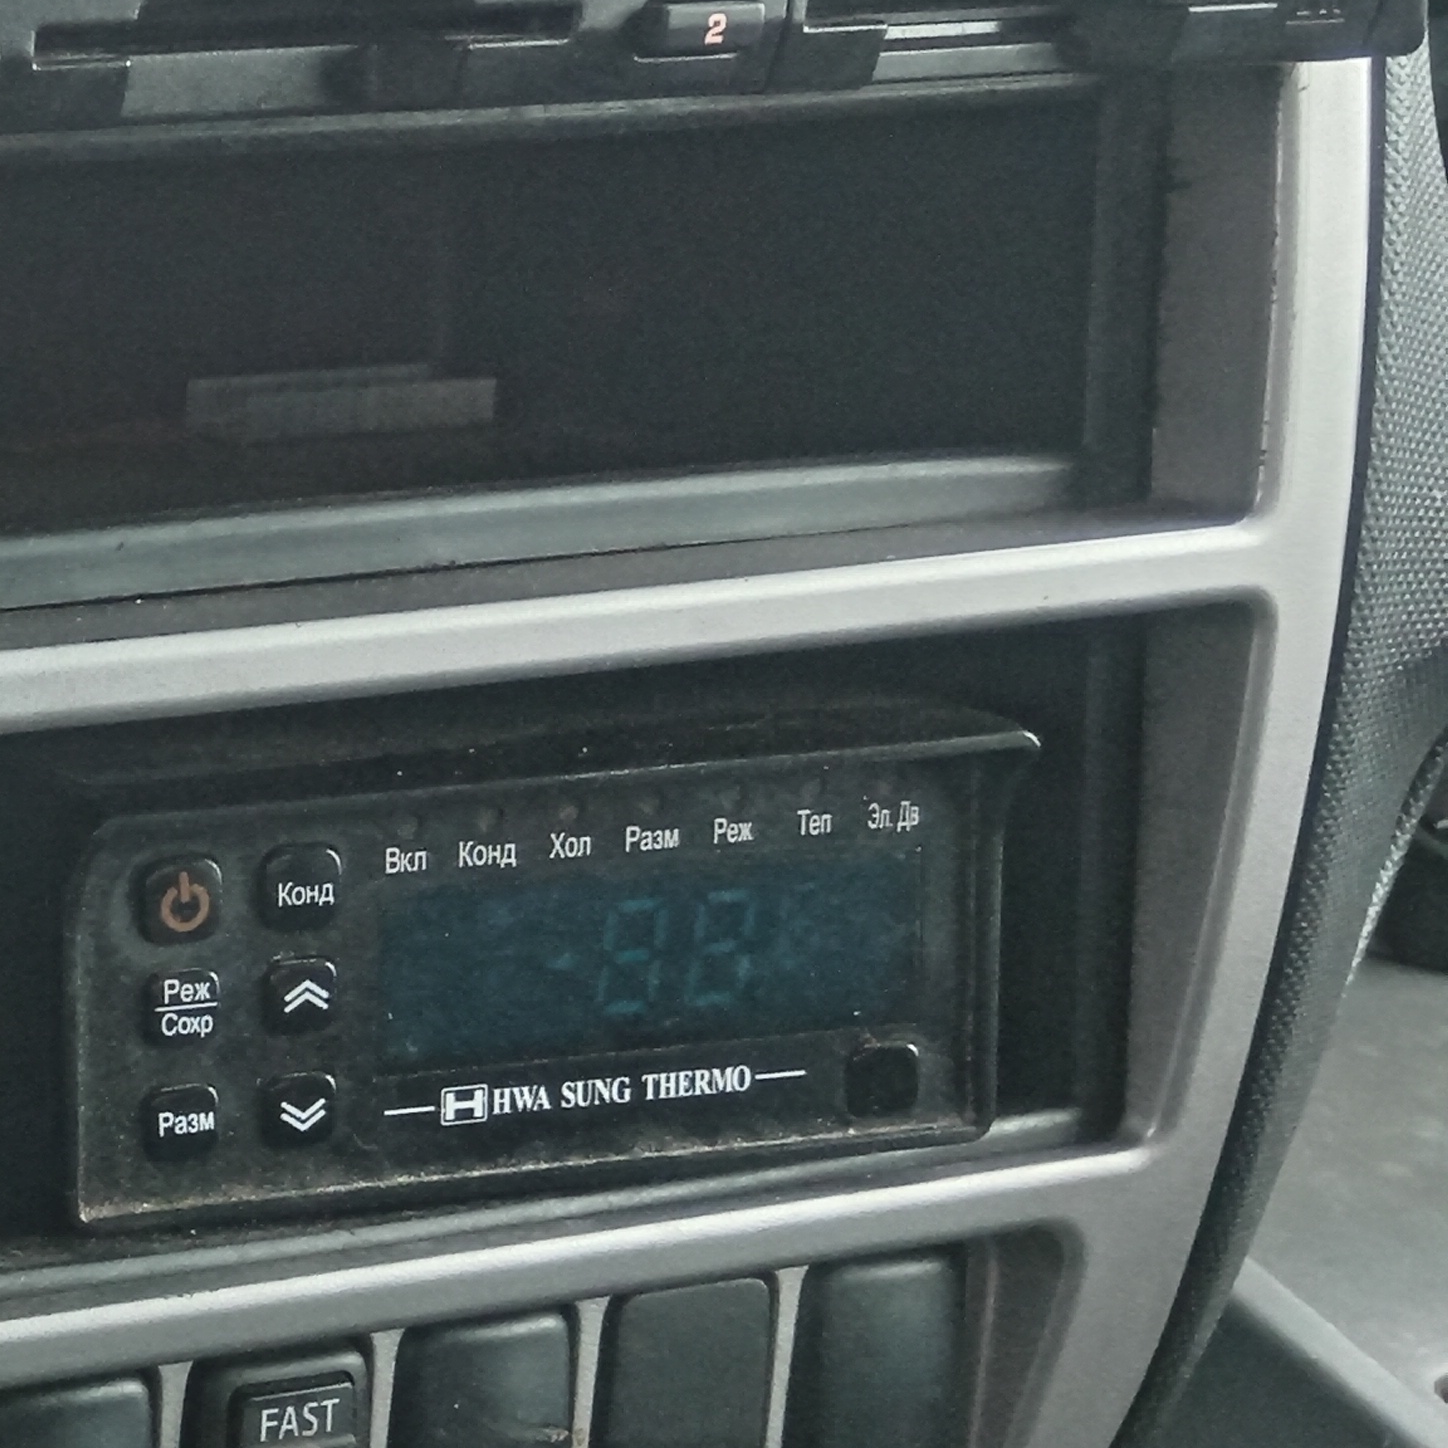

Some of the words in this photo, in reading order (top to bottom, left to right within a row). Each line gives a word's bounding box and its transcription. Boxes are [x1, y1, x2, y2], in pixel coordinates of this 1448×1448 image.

[703, 12, 730, 45] 2
[797, 809, 832, 836] Теп
[867, 803, 893, 829] Эл.
[897, 801, 920, 831] Дв
[625, 826, 679, 852] Разм
[713, 818, 754, 844] Реж
[458, 841, 517, 868] Конд
[549, 833, 591, 859] Хол
[385, 847, 426, 874] Вкл
[277, 881, 335, 907] Конд
[163, 978, 210, 1004] Реж
[161, 1013, 213, 1038] Сохр
[492, 1084, 552, 1115] HWA
[560, 1077, 631, 1110] SUNG
[641, 1065, 752, 1101] THERMO
[158, 1110, 214, 1137] Разм
[260, 1398, 340, 1442] FAST
